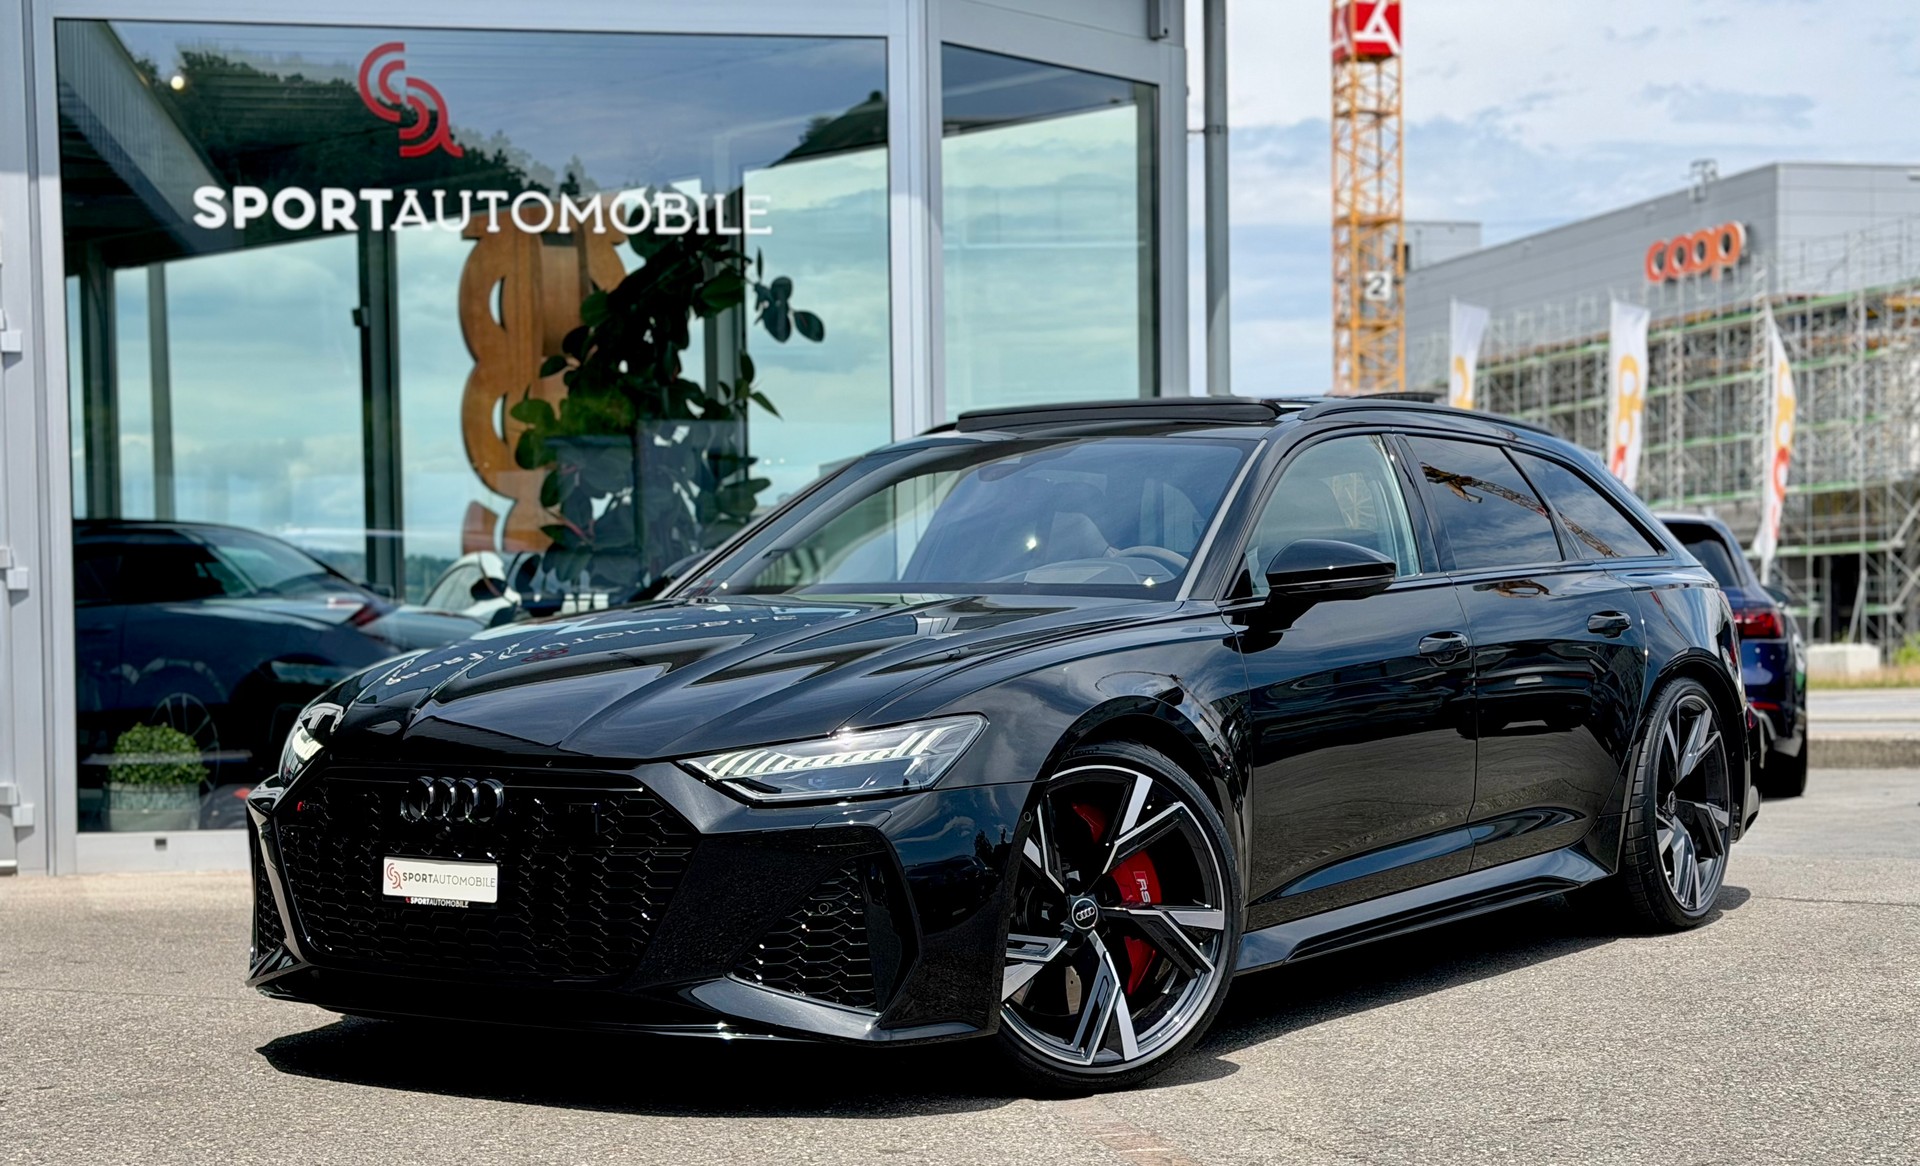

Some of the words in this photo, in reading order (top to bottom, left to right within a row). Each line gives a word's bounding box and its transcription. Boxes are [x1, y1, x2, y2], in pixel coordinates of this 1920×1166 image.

[193, 185, 773, 235] SPORTAUTOMOBILE
[1369, 275, 1386, 296] 2
[402, 872, 496, 888] SPORTAUTOMOBILE
[1136, 878, 1151, 903] RS
[410, 897, 470, 909] SPORTAUTOMOBILE
